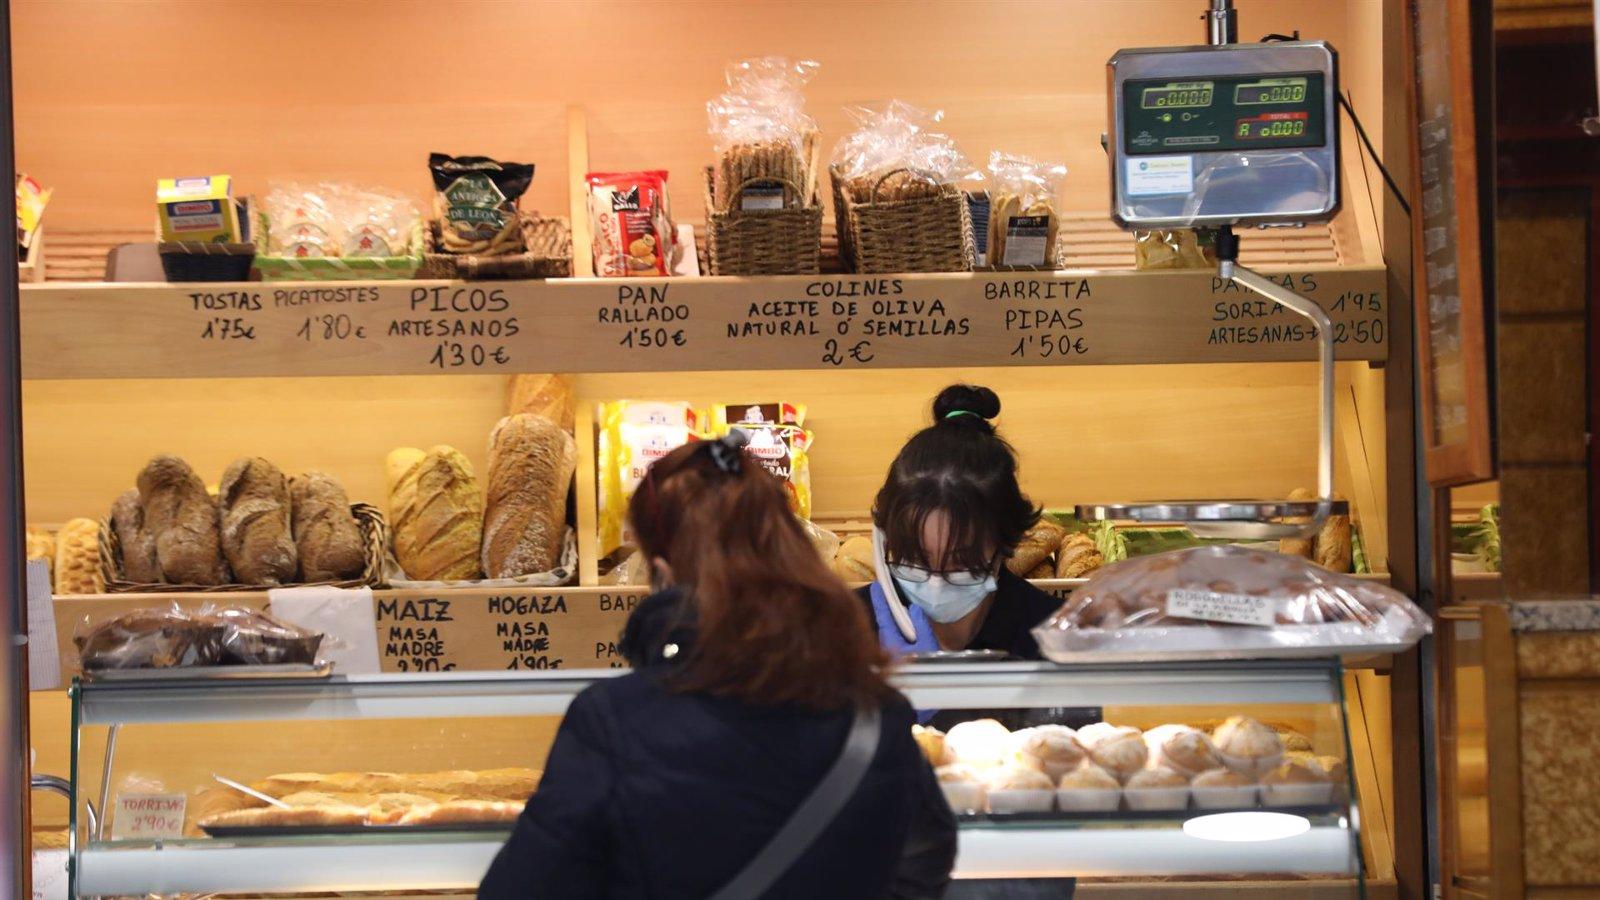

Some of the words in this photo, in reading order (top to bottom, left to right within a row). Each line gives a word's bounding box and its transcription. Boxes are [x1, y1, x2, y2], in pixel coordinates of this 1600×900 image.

[273, 286, 380, 308] PICATOSTES
[618, 282, 670, 306] PAN
[806, 279, 904, 297] COLINES
[984, 279, 1092, 300] BARRITA
[188, 291, 263, 311] TOSTAS
[410, 286, 510, 313] PICOS
[748, 301, 820, 318] ACEITE
[832, 301, 858, 316] DE
[871, 299, 946, 317] OLIVA
[1212, 300, 1285, 322] SORIA
[1330, 290, 1382, 312] 1'95
[598, 304, 690, 324] RALLADO
[1004, 308, 1084, 331] PIPAS
[387, 316, 520, 338] ARTESANOS
[619, 326, 688, 349] 1'50€
[726, 321, 820, 338] NATURAL
[862, 318, 971, 338] SEMILLAS
[1207, 326, 1304, 345] ARTESANAS
[1332, 318, 1384, 344] 2'50
[429, 340, 511, 369] 1'30€
[1010, 334, 1089, 358] 1'50€
[376, 598, 454, 622] MAIZ
[488, 595, 568, 616] HOGAZA
[389, 626, 439, 641] MASA
[496, 621, 550, 637] MASA
[385, 640, 445, 657] MADRE
[503, 636, 550, 655] MADRE
